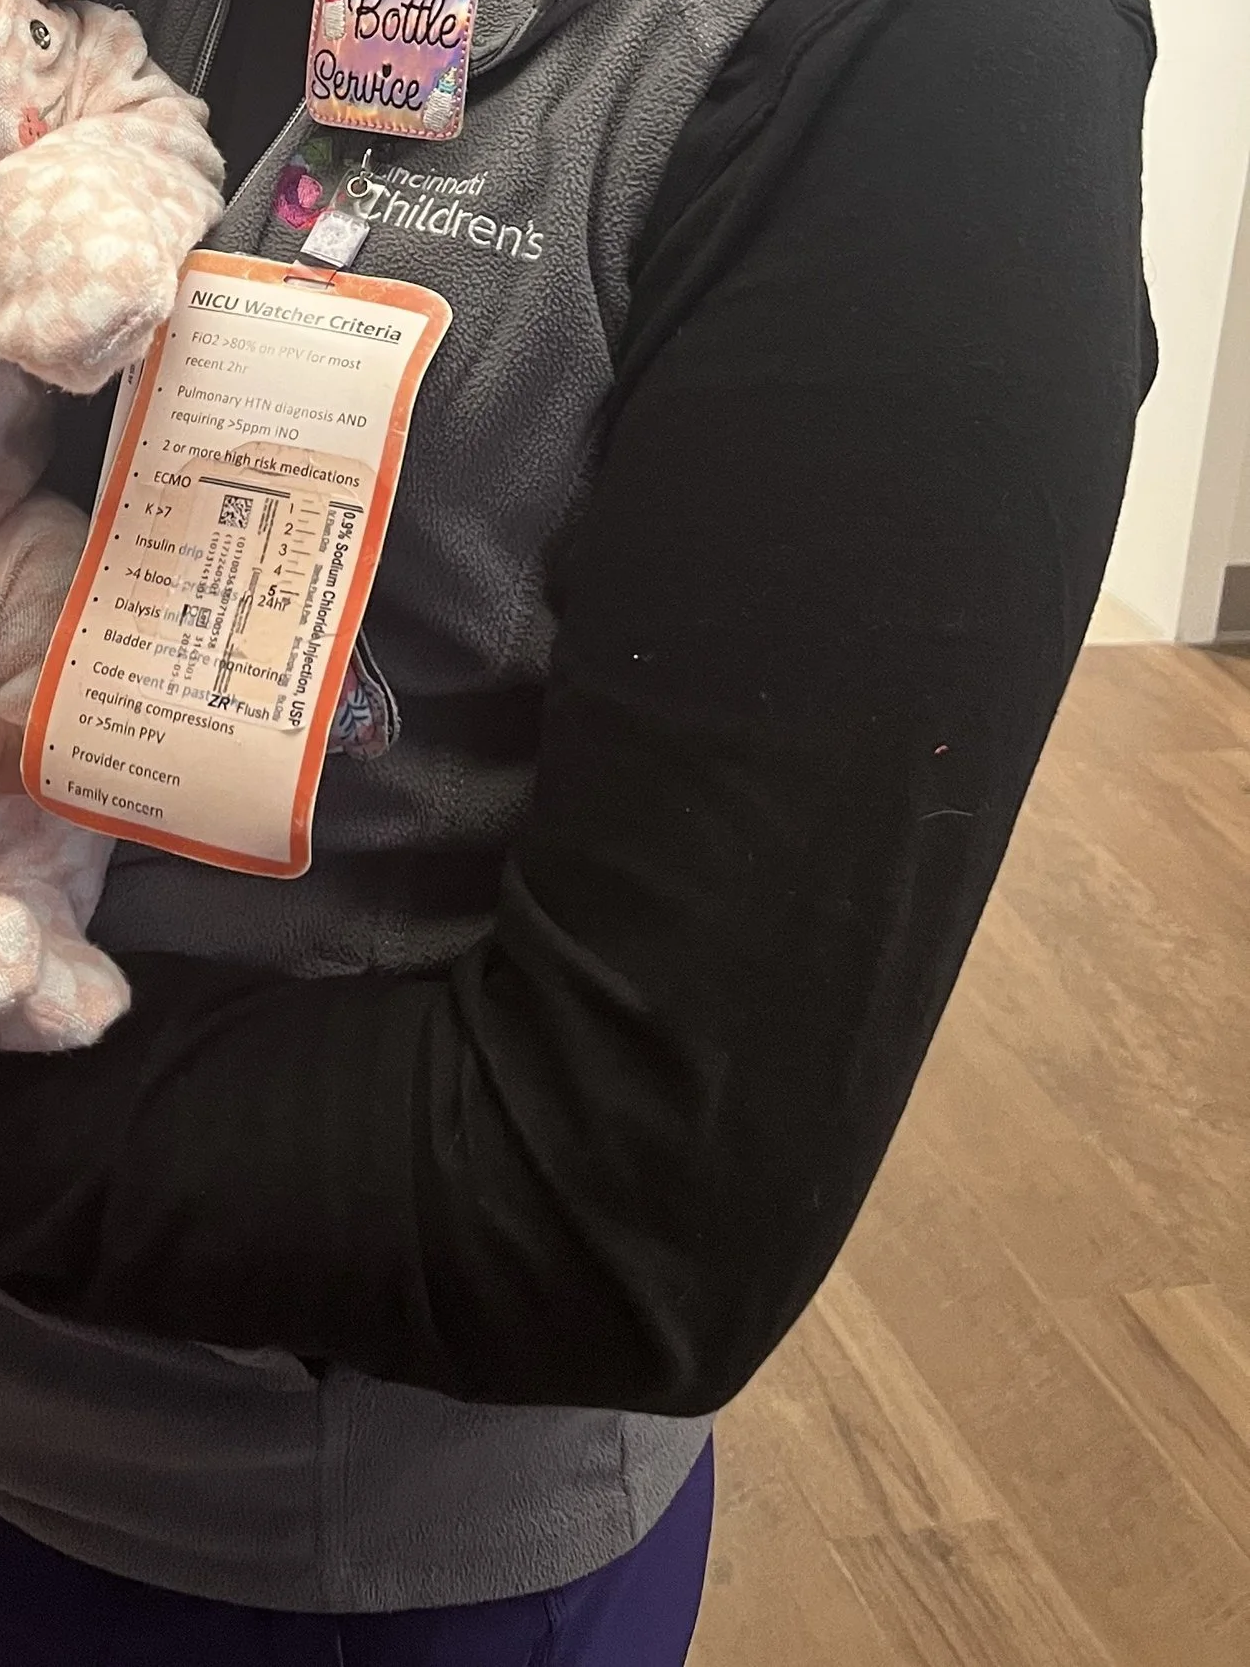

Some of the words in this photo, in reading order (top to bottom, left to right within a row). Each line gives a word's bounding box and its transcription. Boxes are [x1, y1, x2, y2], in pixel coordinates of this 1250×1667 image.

[311, 49, 423, 111] Service
[353, 187, 544, 260] Children's
[190, 290, 240, 311] NICU
[244, 299, 324, 326] Watcher
[329, 315, 403, 342] Criteria
[185, 356, 224, 372] recent
[227, 359, 248, 374] 2hr
[191, 331, 219, 347] FiO2
[222, 337, 256, 352] >80%
[259, 344, 275, 355] on
[278, 345, 304, 360] PPV
[306, 349, 326, 364] for
[328, 356, 362, 371] most
[177, 385, 242, 409] Pulmonary
[244, 396, 271, 411] HTN
[274, 401, 334, 423] diagnosis
[336, 413, 367, 428] AND
[170, 410, 225, 431] requiring
[227, 418, 271, 438] >5ppm
[274, 425, 300, 441] iNO
[154, 471, 192, 488] ECMO
[162, 440, 170, 451] 2
[173, 444, 186, 453] or
[188, 446, 221, 462] more
[223, 449, 251, 468] high
[254, 456, 277, 471] risk
[280, 460, 360, 488] medications
[145, 502, 154, 514] K
[156, 505, 172, 518] >7
[289, 502, 295, 515] 1
[284, 523, 294, 535] 2
[337, 510, 357, 541] 0.9%
[134, 534, 176, 555] Insulin
[179, 544, 204, 561] drip
[278, 544, 288, 557] 3
[273, 565, 282, 576] 4
[325, 541, 349, 589] Sodium
[125, 567, 142, 581] >4
[257, 596, 287, 613] 24hr
[267, 585, 277, 597] 5
[114, 597, 161, 620] Dialysis
[310, 588, 336, 641] Chloride
[103, 628, 153, 652] Bladder
[93, 660, 126, 681] Code
[128, 671, 164, 691] event
[182, 684, 210, 704] past
[292, 640, 321, 699] Injection,
[85, 687, 143, 714] requiring
[146, 702, 235, 735] compressions
[207, 694, 230, 710] ZR
[236, 700, 270, 721] Flush
[286, 699, 306, 727] USP
[79, 713, 94, 725] or
[97, 717, 136, 738] >5min
[139, 727, 166, 745] PPV
[72, 745, 126, 771] Provider
[129, 762, 180, 786] concern
[68, 781, 109, 805] Family
[111, 795, 164, 818] concern
